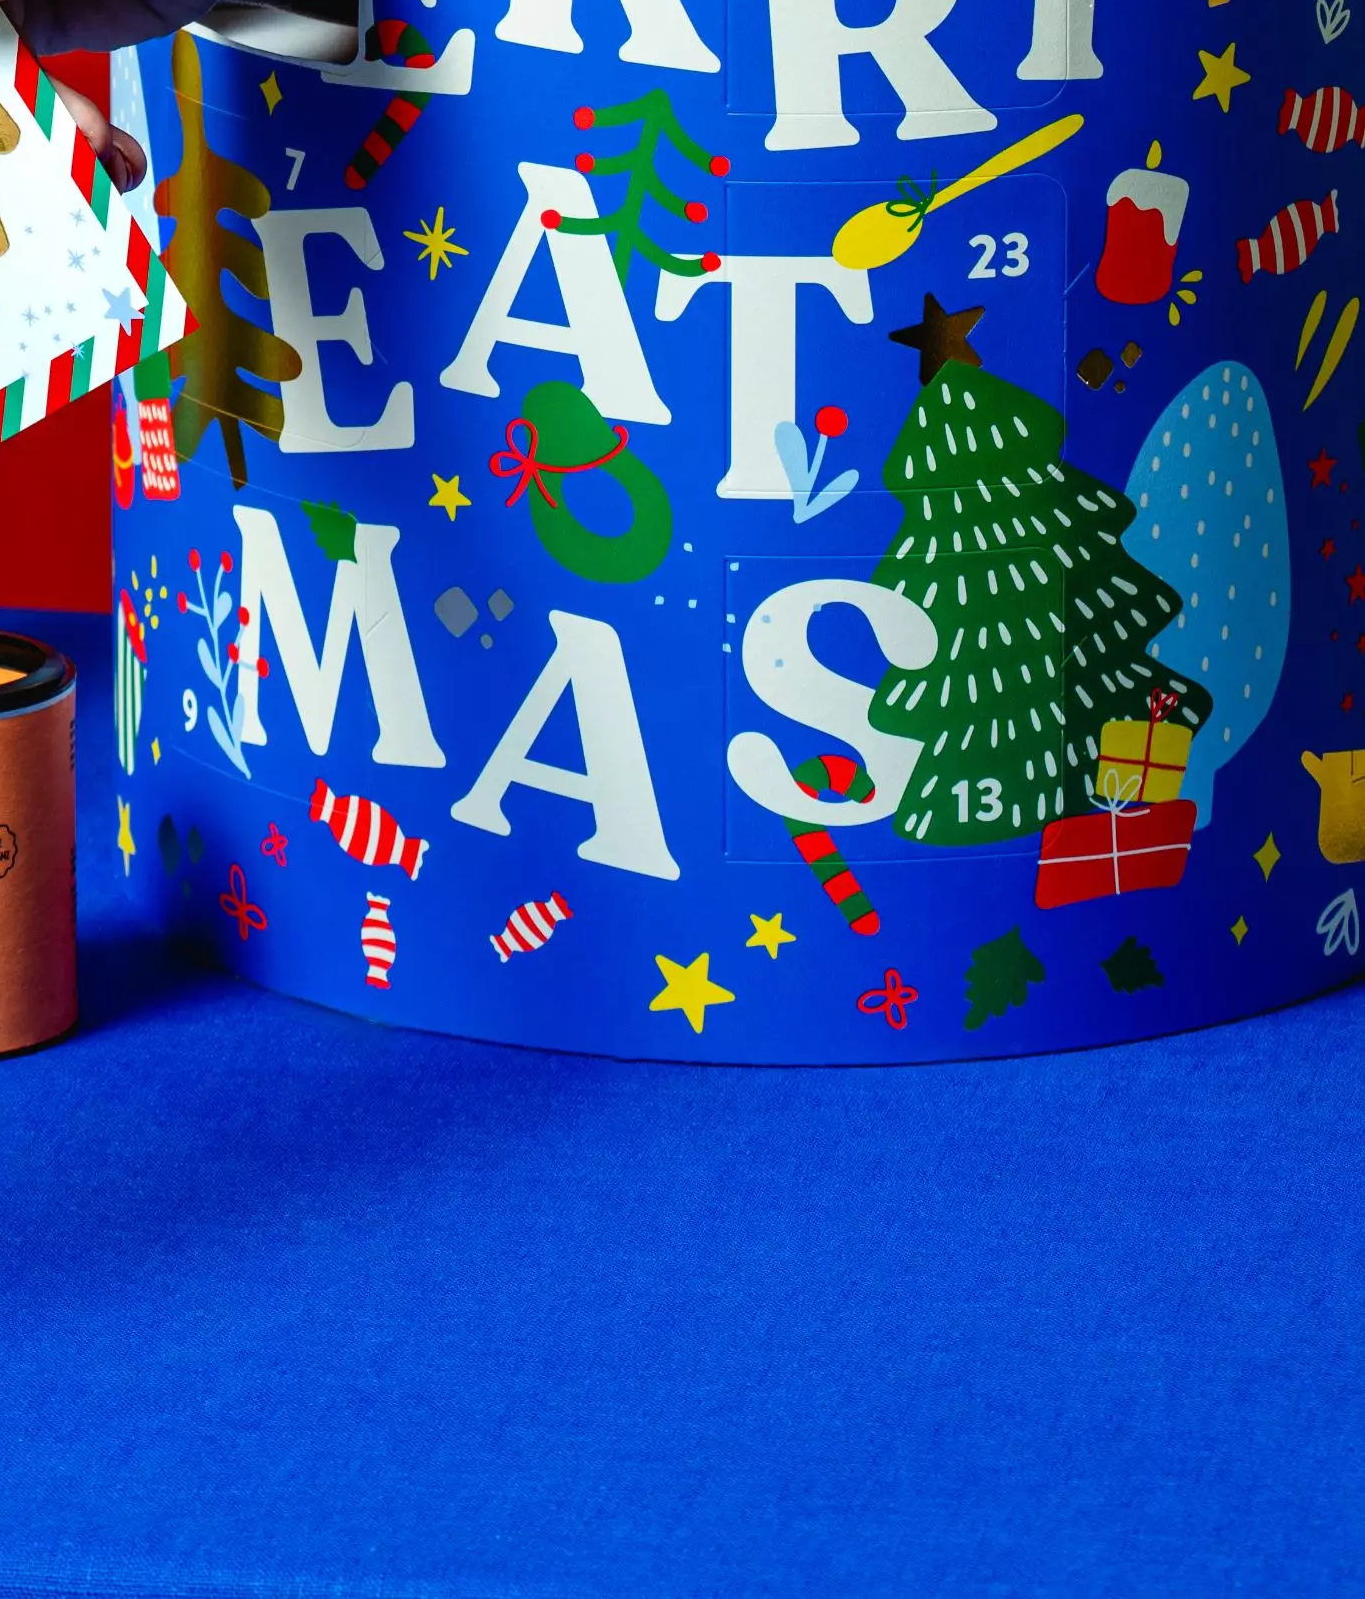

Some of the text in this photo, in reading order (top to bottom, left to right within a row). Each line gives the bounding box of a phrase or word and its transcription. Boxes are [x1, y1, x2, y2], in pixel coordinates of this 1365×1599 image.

[285, 147, 306, 190] 7
[967, 232, 1030, 279] 23
[250, 161, 874, 500] EAT
[182, 688, 198, 732] 9
[232, 504, 938, 881] MAS
[951, 777, 1004, 823] 13
